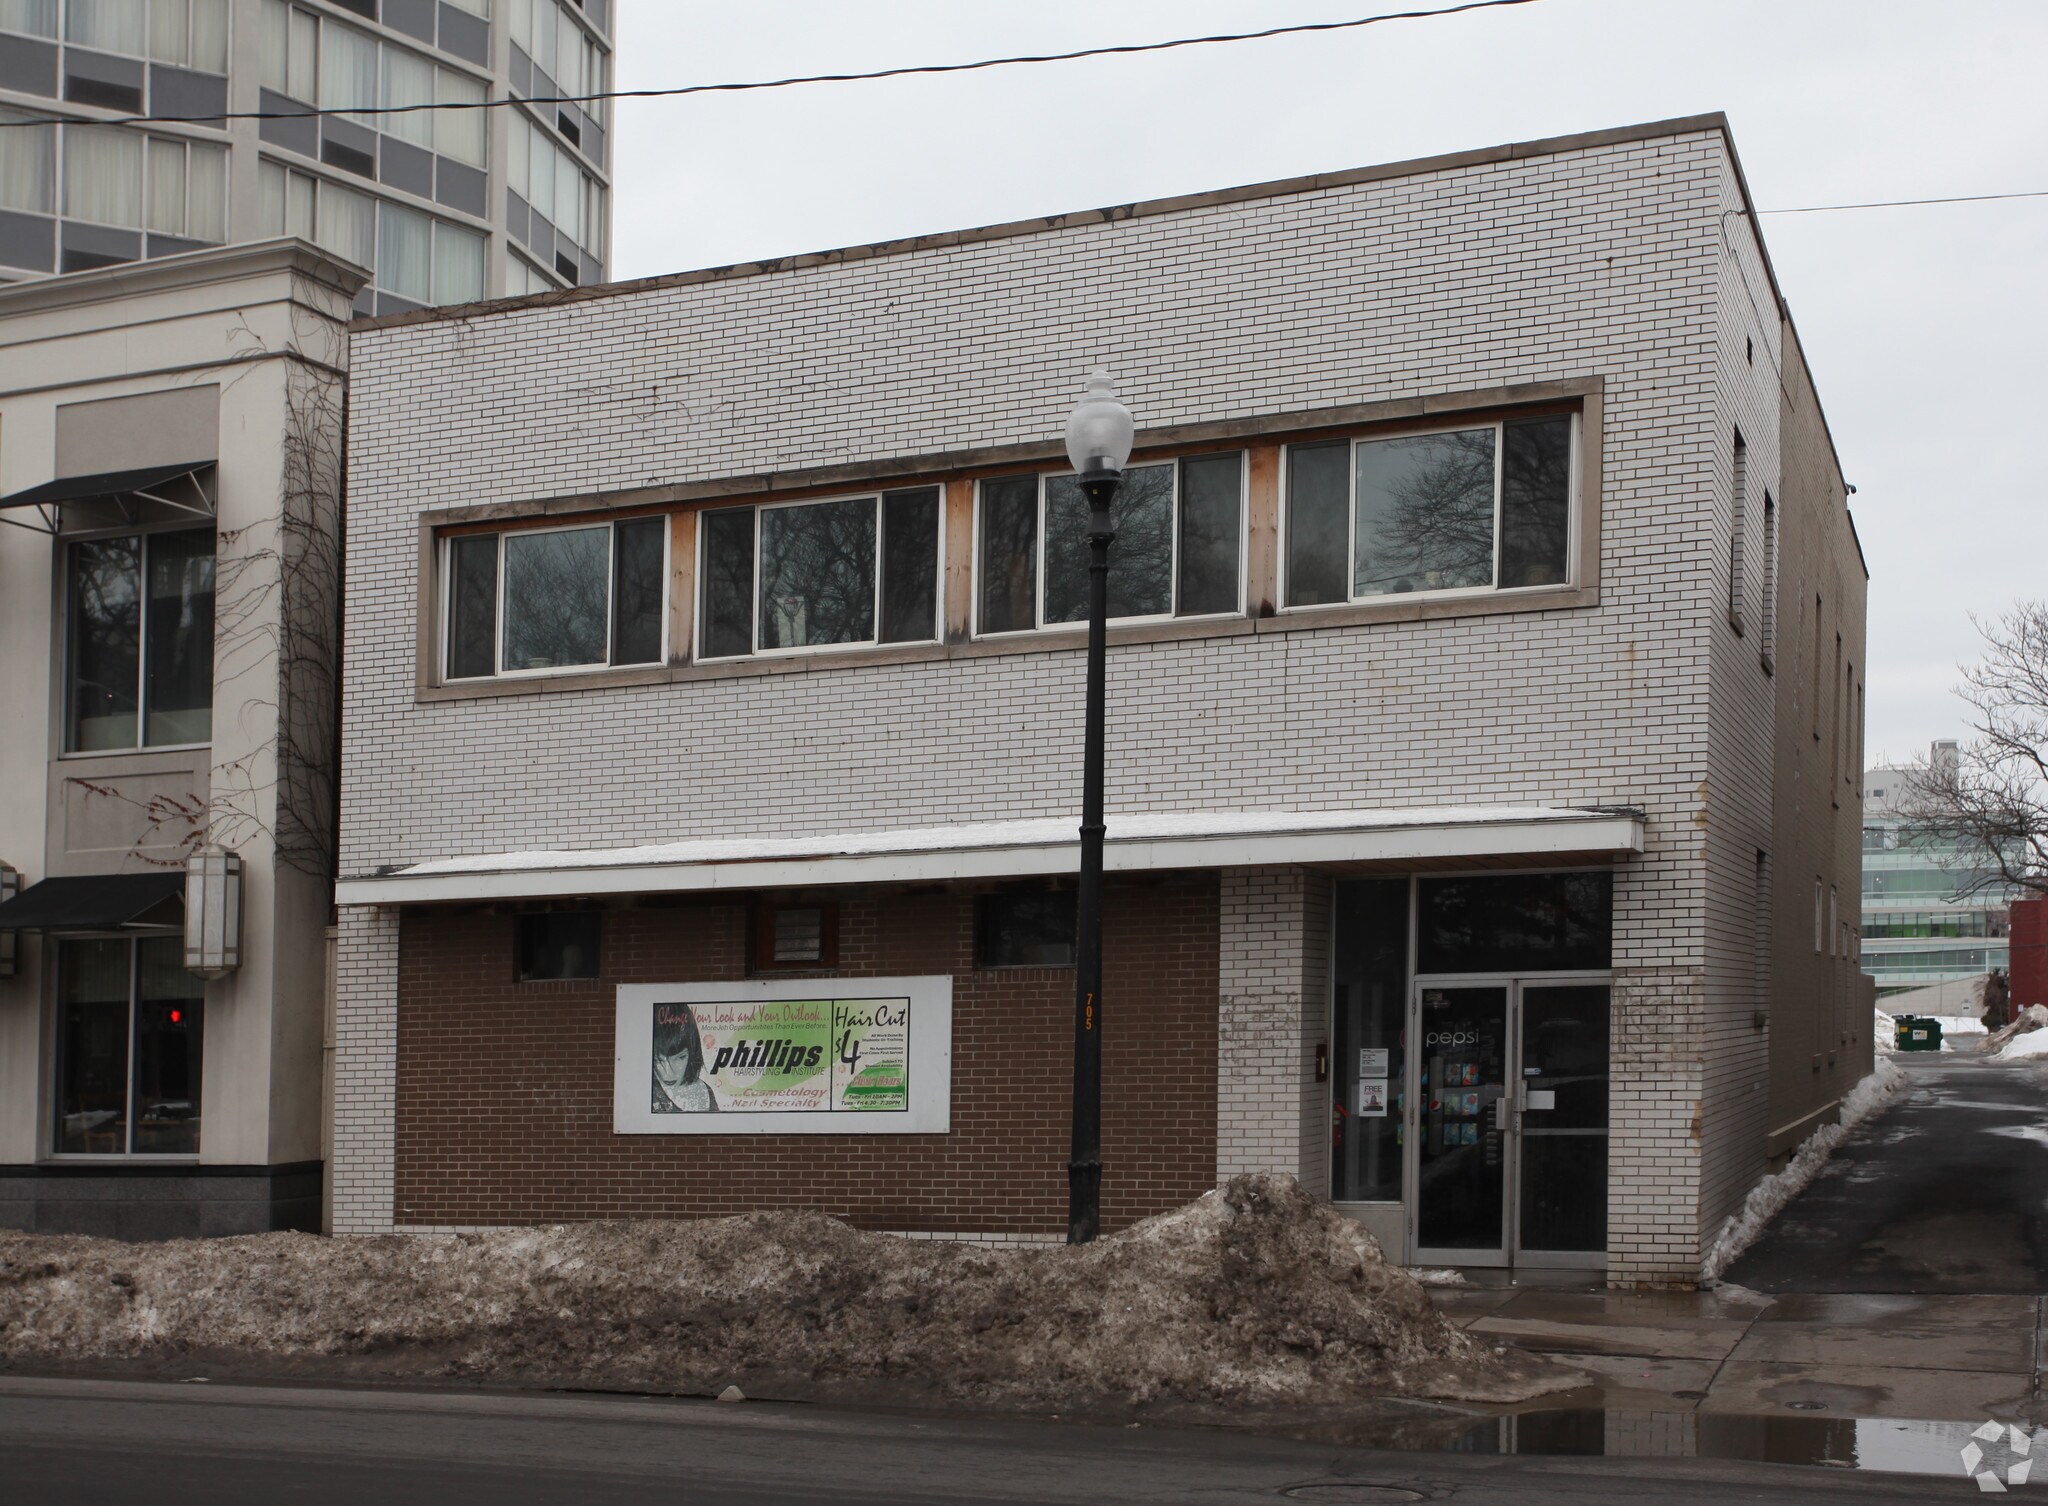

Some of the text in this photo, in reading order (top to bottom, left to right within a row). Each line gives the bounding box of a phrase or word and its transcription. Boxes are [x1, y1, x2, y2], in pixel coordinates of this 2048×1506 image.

[658, 1006, 688, 1029] Change
[690, 1006, 711, 1023] Your
[715, 1005, 735, 1023] Look
[737, 1005, 756, 1022] and
[758, 1004, 780, 1022] Your
[835, 1005, 906, 1029] Hair Cut
[1085, 993, 1093, 1030] 705
[1426, 1028, 1479, 1047] pepsi
[710, 1039, 823, 1074] phillips
[734, 1066, 825, 1076] HAIRSTYLING INSTITUTE
[760, 1099, 821, 1108] Specialty
